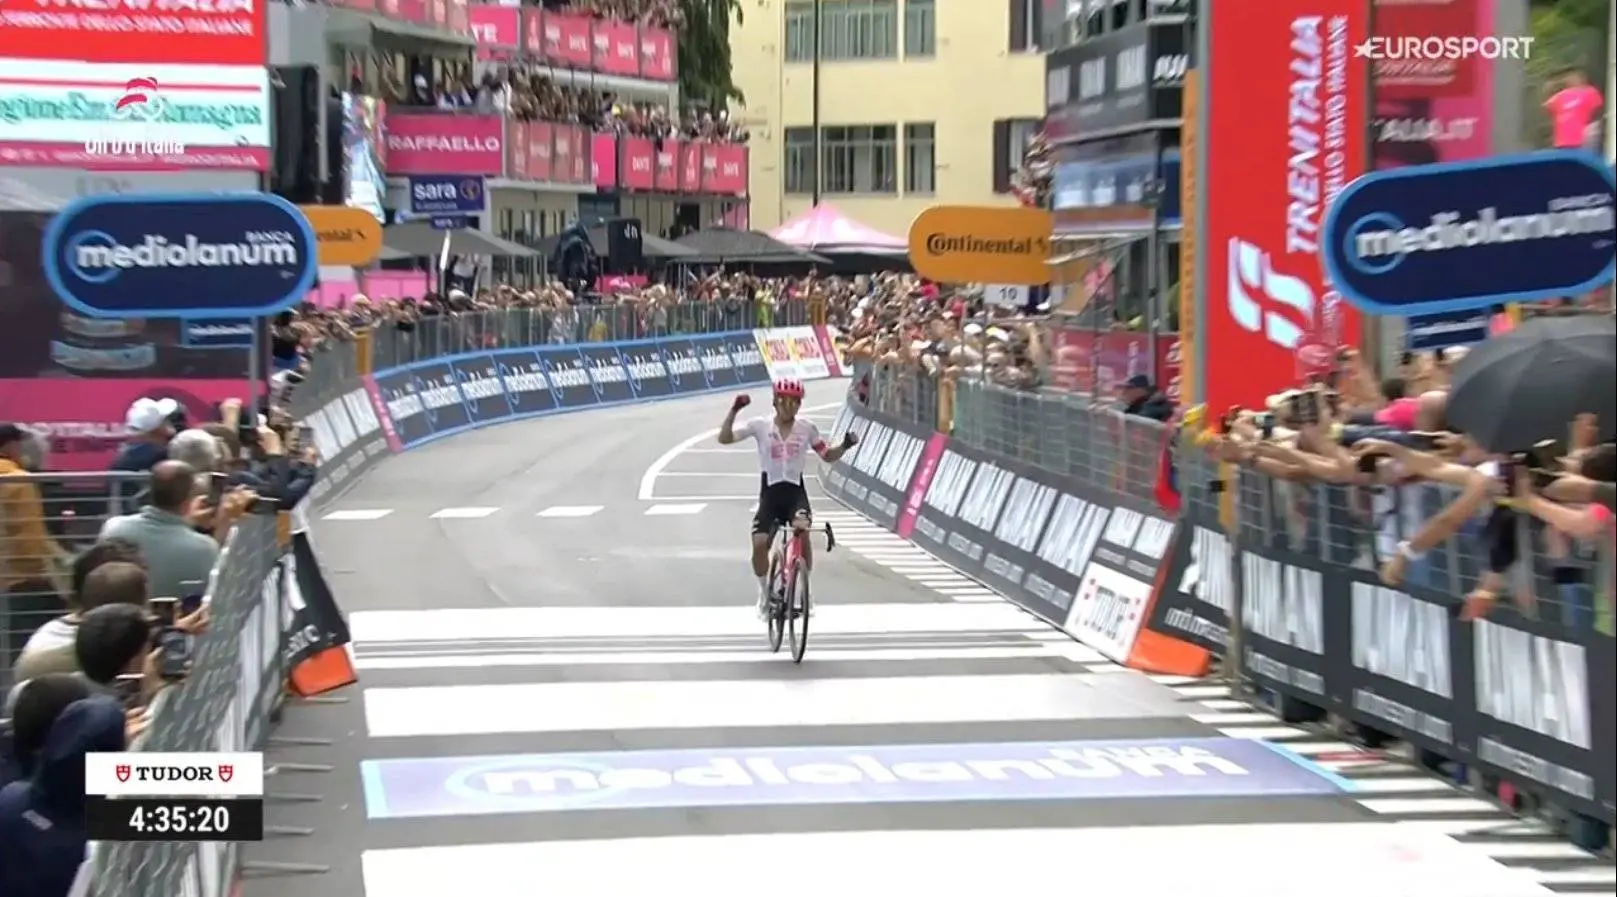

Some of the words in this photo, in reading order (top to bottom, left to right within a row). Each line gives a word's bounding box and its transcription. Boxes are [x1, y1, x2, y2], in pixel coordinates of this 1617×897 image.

[388, 135, 501, 152] RAFFAELLO
[1287, 14, 1323, 254] TRENITALIA
[414, 183, 457, 200] sara
[926, 232, 1032, 256] Continental
[1356, 206, 1615, 258] mediolanum
[76, 233, 297, 268] mediolanum
[999, 286, 1018, 300] 10
[483, 755, 1249, 794] mediolanum
